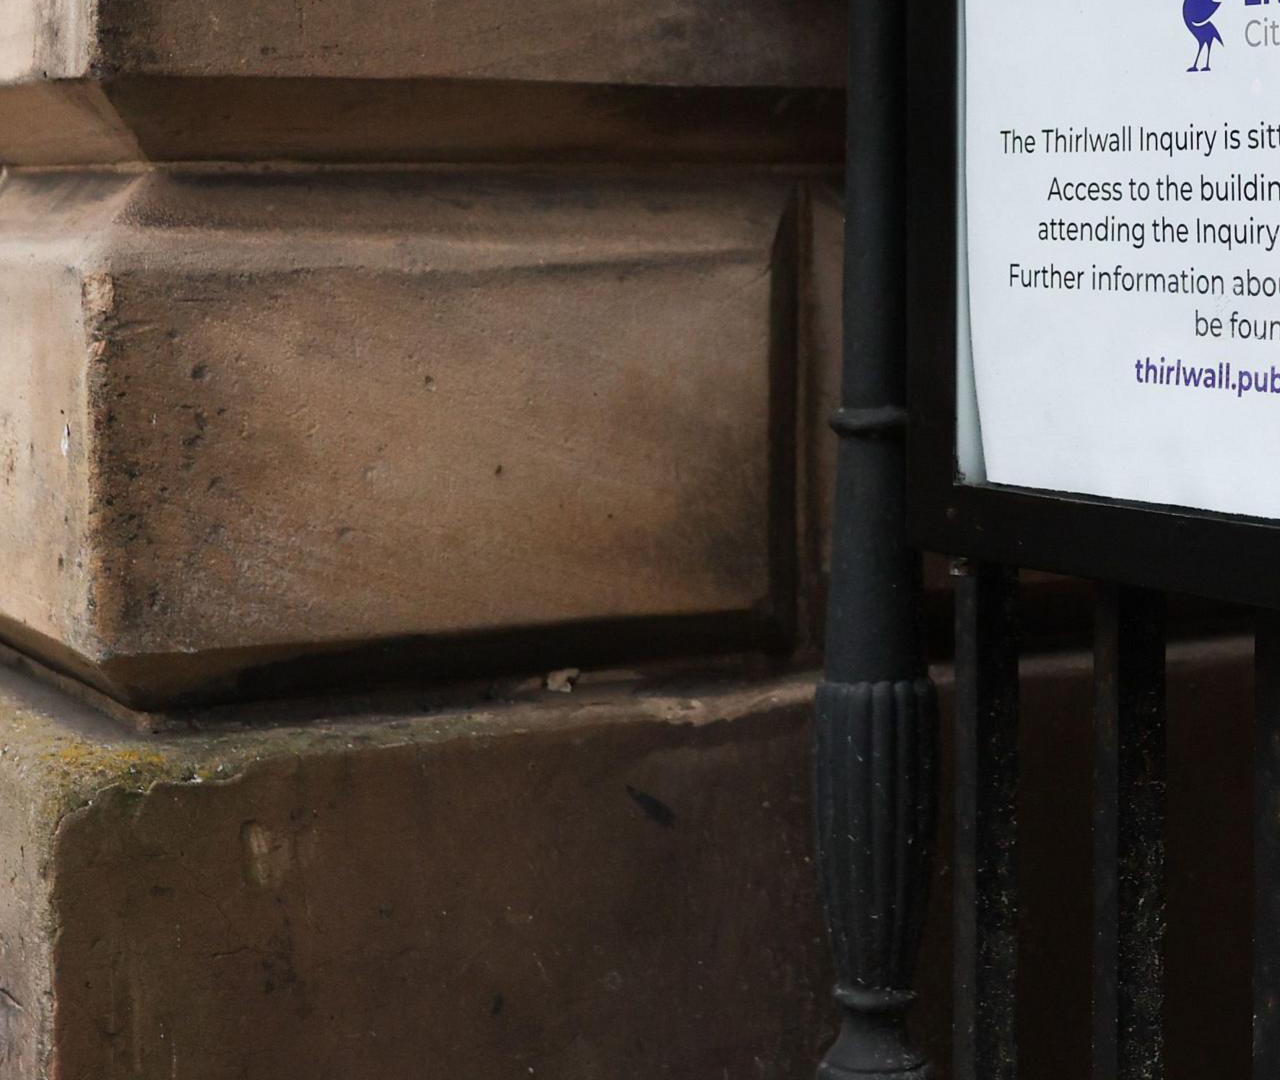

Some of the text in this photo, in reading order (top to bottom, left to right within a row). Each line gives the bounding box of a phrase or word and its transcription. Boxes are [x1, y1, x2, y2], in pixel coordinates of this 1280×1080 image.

[999, 128, 1037, 155] The
[1040, 124, 1132, 154] Thirlwall
[1139, 122, 1218, 159] Inquiry
[1223, 121, 1242, 151] is
[1046, 176, 1124, 202] Access
[1127, 177, 1151, 202] to
[1155, 173, 1194, 203] the
[1037, 214, 1146, 250] attending
[1150, 215, 1190, 244] the
[1196, 215, 1280, 253] Inquiry
[1009, 262, 1086, 291] Further
[1091, 263, 1225, 301] information
[1194, 308, 1224, 339] be
